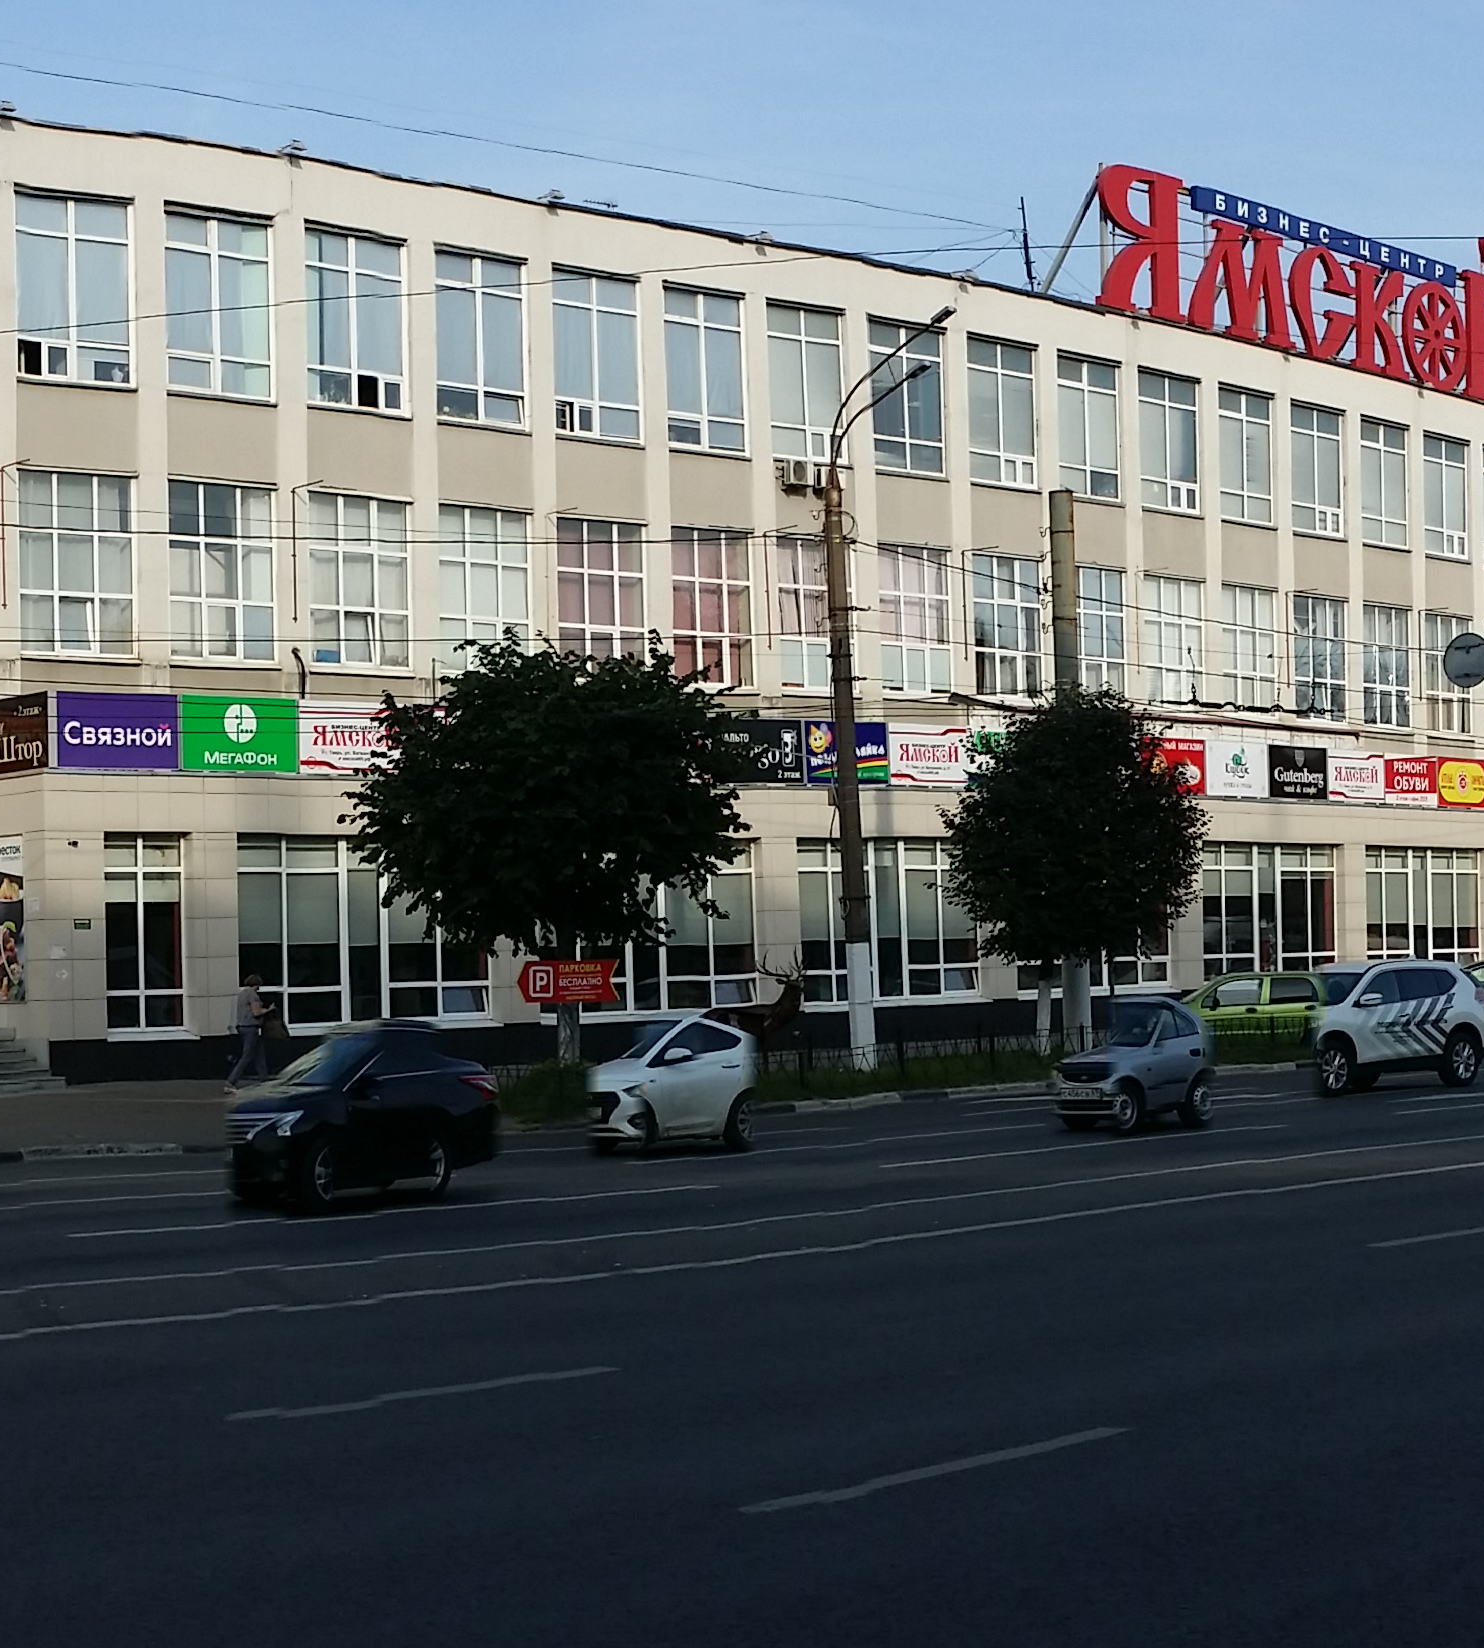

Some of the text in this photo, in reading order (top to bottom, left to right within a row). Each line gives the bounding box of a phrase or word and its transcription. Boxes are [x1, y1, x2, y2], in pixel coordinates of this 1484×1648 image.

[1215, 193, 1445, 278] БИЗНЕС-ЦЕНТР
[722, 732, 750, 743] АЛЬТО
[1178, 742, 1203, 751] МАГАЗИН
[1393, 761, 1428, 775] РЕМОНТ
[1274, 767, 1324, 788] Gutenberg
[1394, 776, 1429, 792] ОБУВИ
[558, 963, 602, 973] ПАРКОВКА
[558, 977, 603, 987] БЕСПЛАТНО
